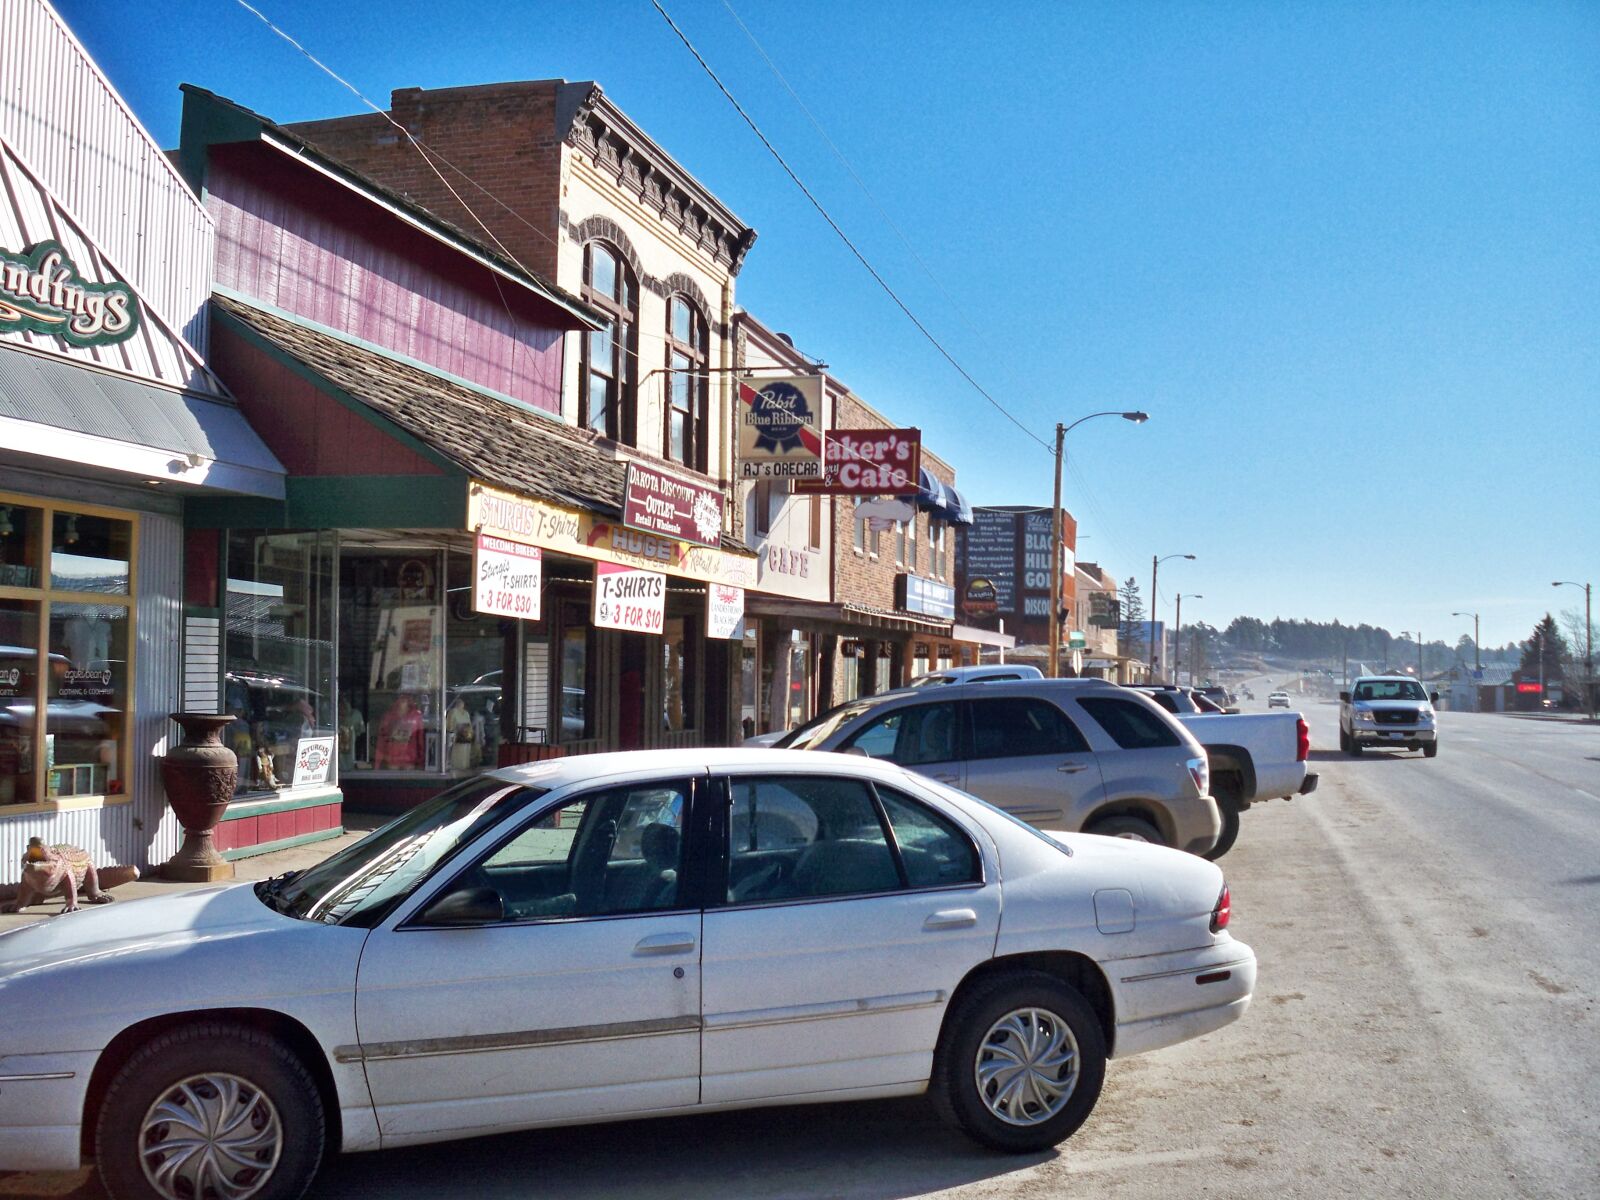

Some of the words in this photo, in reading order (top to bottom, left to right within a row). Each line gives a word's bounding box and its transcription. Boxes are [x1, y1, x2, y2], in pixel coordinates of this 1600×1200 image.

[0, 251, 130, 335] ndings
[760, 390, 797, 410] Pabst
[747, 412, 770, 425] Blue
[772, 412, 813, 425] Ribbon
[826, 435, 910, 461] aker's
[773, 462, 819, 476] ORECAR
[840, 463, 908, 488] Cafe
[630, 466, 659, 493] DAKOTA
[660, 477, 697, 504] DISCOUNT
[645, 494, 676, 520] OUTLET
[480, 494, 535, 537] STURGIS
[537, 510, 581, 543] T-Shirts
[482, 538, 516, 553] WELCOME
[515, 543, 539, 557] BIKERS
[612, 527, 672, 562] HUGE
[1025, 534, 1054, 551] BLAC
[480, 560, 511, 582] Sturgis
[610, 551, 671, 571] INVENTORY
[503, 575, 538, 590] T-SHIRTS
[602, 577, 662, 599] T-SHIRTS
[1025, 571, 1052, 588] GOL
[487, 591, 493, 608] 3
[496, 592, 512, 611] FOR
[514, 595, 531, 614] $30
[614, 604, 621, 625] 3
[624, 605, 643, 627] FOR
[645, 609, 661, 630] $10
[301, 743, 330, 759] STURGIS
